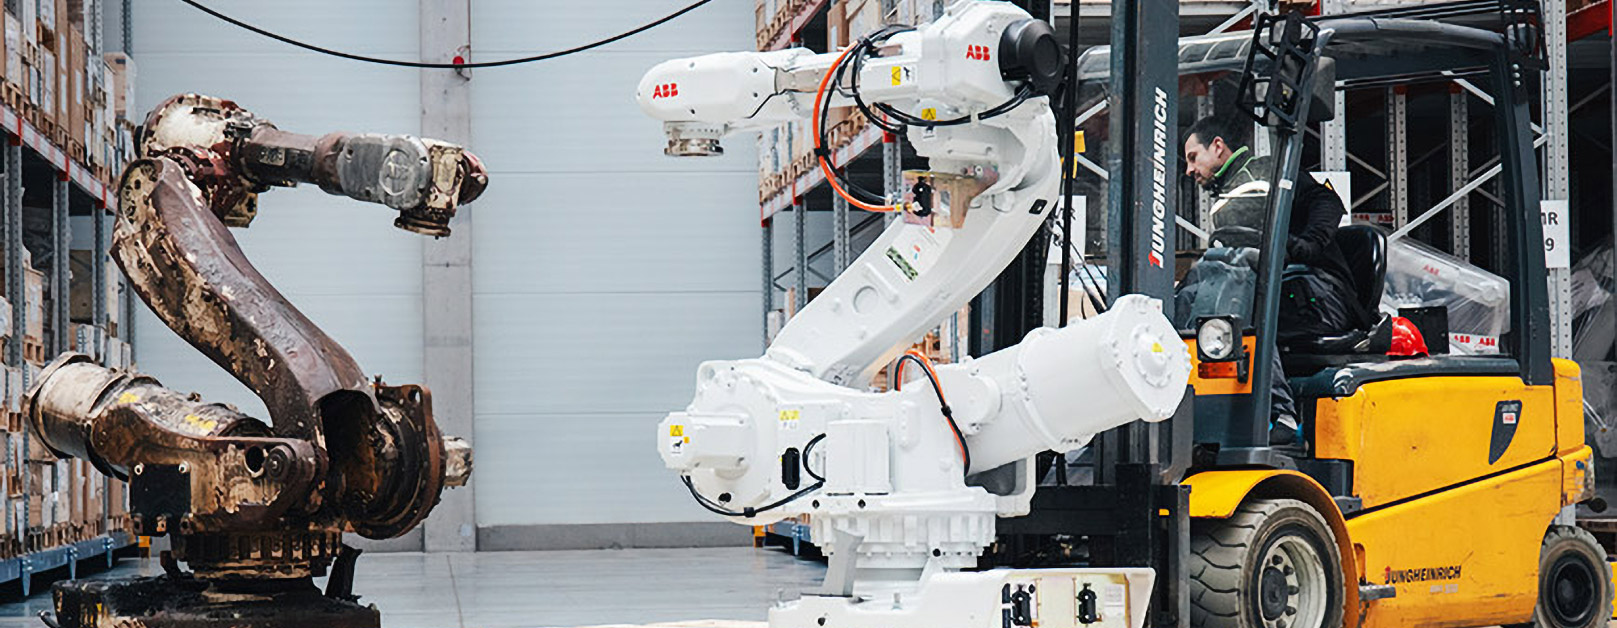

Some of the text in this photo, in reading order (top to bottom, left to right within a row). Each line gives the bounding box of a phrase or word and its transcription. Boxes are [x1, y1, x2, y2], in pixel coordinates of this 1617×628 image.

[966, 44, 990, 61] ABB
[652, 83, 679, 100] ABB
[1148, 87, 1167, 268] JUNGHEINRICH
[1385, 565, 1461, 584] JUNGHEINRICH
